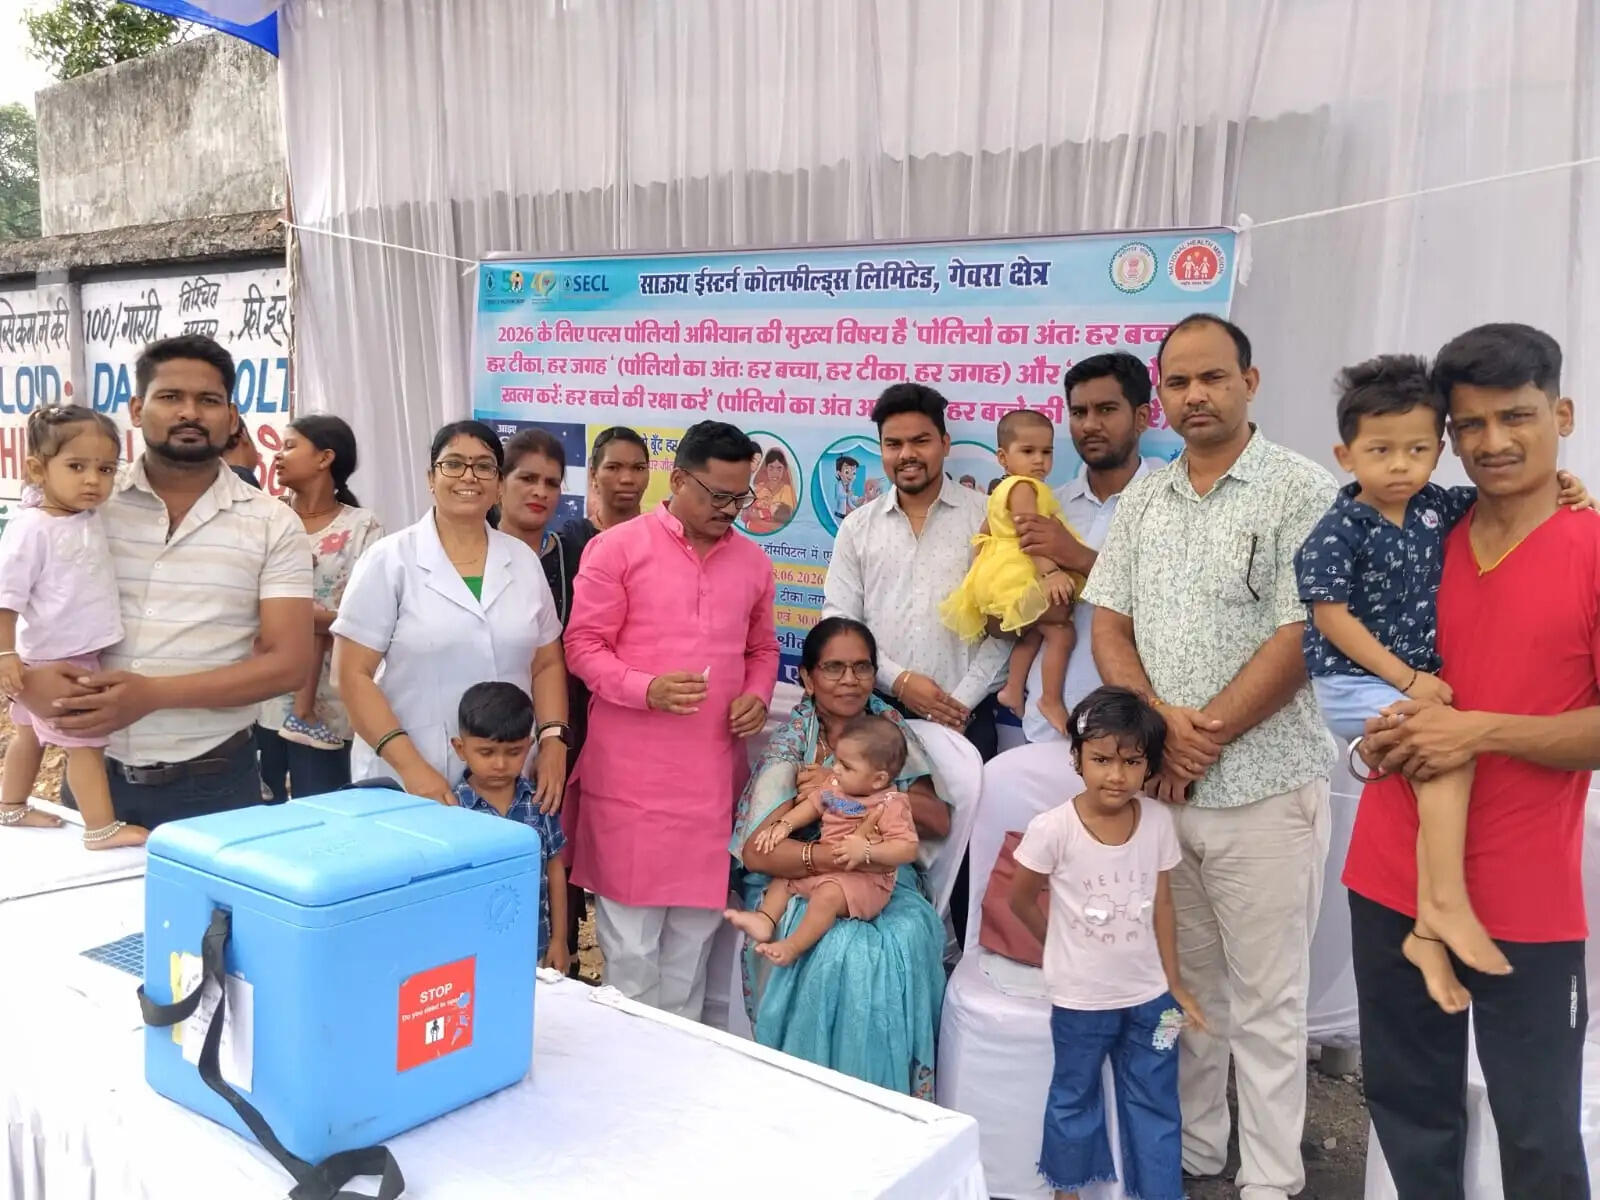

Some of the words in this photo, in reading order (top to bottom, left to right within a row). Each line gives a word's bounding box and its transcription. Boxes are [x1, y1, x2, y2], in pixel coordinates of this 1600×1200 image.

[573, 274, 609, 292] SECL
[694, 266, 741, 296] ईस्टर्न
[744, 264, 851, 297] कोलफील्ड्स
[856, 260, 940, 293] लिमिटेड,
[949, 257, 1005, 288] गेवरा
[1010, 255, 1051, 286] क्षेत्र
[498, 327, 533, 343] 2026
[537, 321, 552, 343] के
[555, 319, 584, 343] लिए
[587, 326, 621, 343] पल्स
[624, 319, 680, 344] पोलियो
[684, 319, 753, 344] अभियान
[756, 318, 782, 344] की
[785, 326, 833, 350] मुख्य
[837, 317, 889, 345] विषय
[892, 317, 908, 345] है
[997, 325, 1030, 345] का
[1085, 325, 1120, 345] हर
[486, 356, 506, 373] हर
[509, 351, 544, 376] टीका,
[547, 358, 567, 375] हर
[570, 358, 607, 376] जगह
[617, 352, 681, 377] (पोलियो
[683, 360, 707, 377] का
[747, 361, 771, 379] हर
[775, 361, 822, 383] बच्चा,
[826, 363, 853, 381] हर
[914, 364, 944, 383] हर
[947, 360, 1012, 386] जगह)
[1016, 355, 1061, 385] और
[93, 362, 133, 414] DA
[501, 387, 534, 403] खत्म
[565, 390, 587, 407] हर
[589, 385, 619, 408] बच्चे
[622, 385, 645, 408] की
[647, 391, 678, 411] रक्षा
[717, 387, 786, 415] (पोलियो
[789, 397, 815, 416] का
[819, 393, 851, 417] अंत
[946, 402, 977, 421] हर
[811, 544, 819, 560] में
[780, 587, 804, 603] टीका
[807, 593, 826, 605] लग
[420, 982, 453, 1004] STOP
